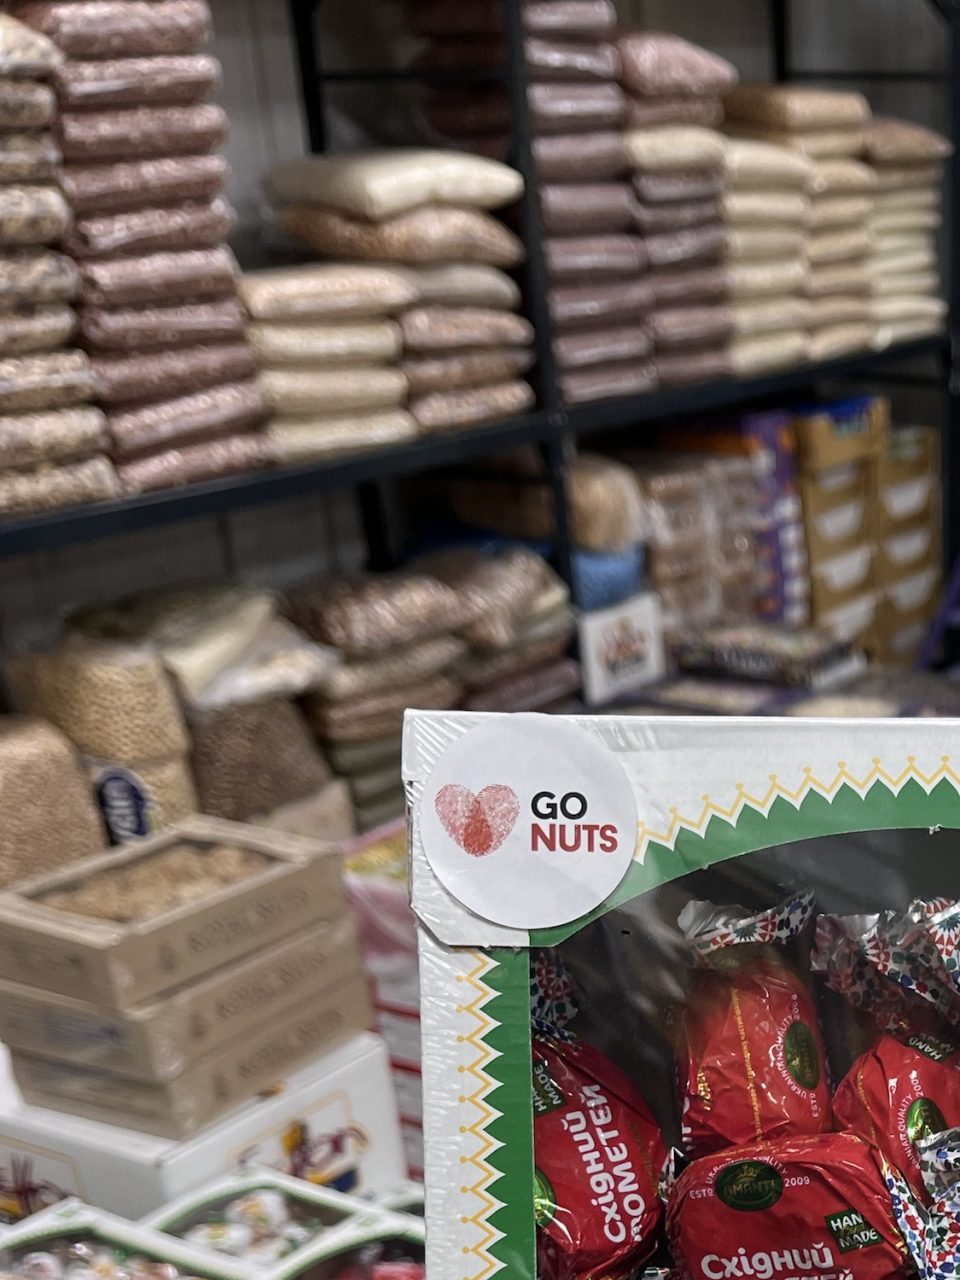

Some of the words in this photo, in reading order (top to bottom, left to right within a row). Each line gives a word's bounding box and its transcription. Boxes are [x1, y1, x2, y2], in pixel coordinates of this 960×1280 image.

[530, 790, 589, 821] GO
[530, 823, 619, 853] NUTS
[907, 1036, 943, 1061] HAND
[897, 1092, 914, 1132] QUALITY
[560, 1110, 628, 1243] Східний
[784, 1175, 811, 1188] 2009
[830, 1212, 865, 1232] HAN
[839, 1229, 879, 1249] MADE
[700, 1241, 835, 1280] Східний
